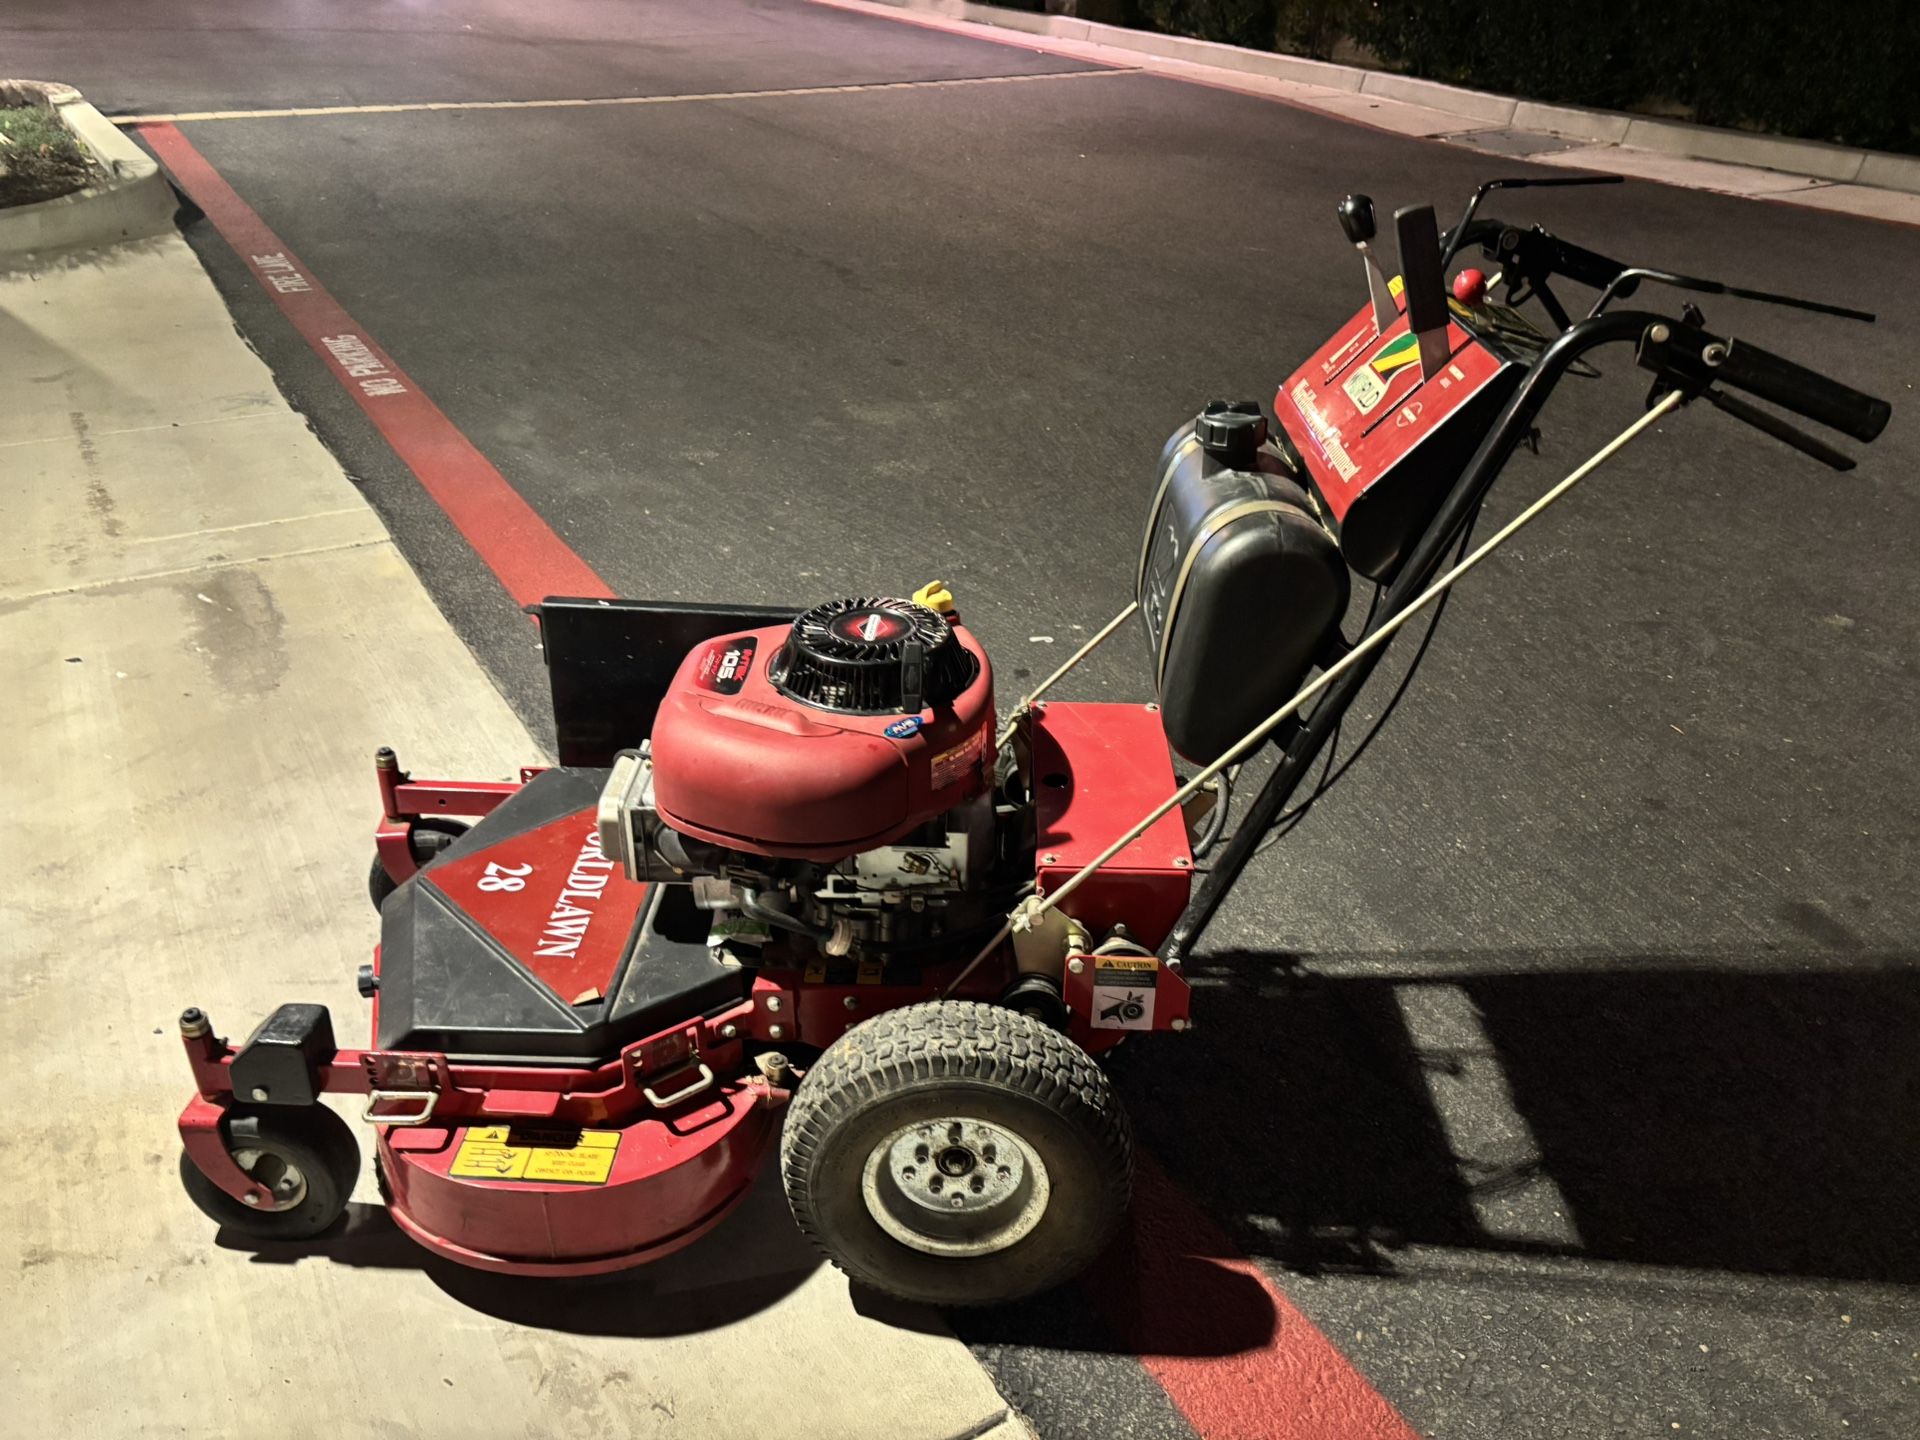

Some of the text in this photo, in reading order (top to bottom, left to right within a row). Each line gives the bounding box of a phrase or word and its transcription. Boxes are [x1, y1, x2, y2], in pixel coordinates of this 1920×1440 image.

[320, 334, 407, 397] NO PARKING
[477, 861, 534, 892] 28
[533, 823, 615, 959] RLDLAWN
[1116, 960, 1152, 969] CAUTION
